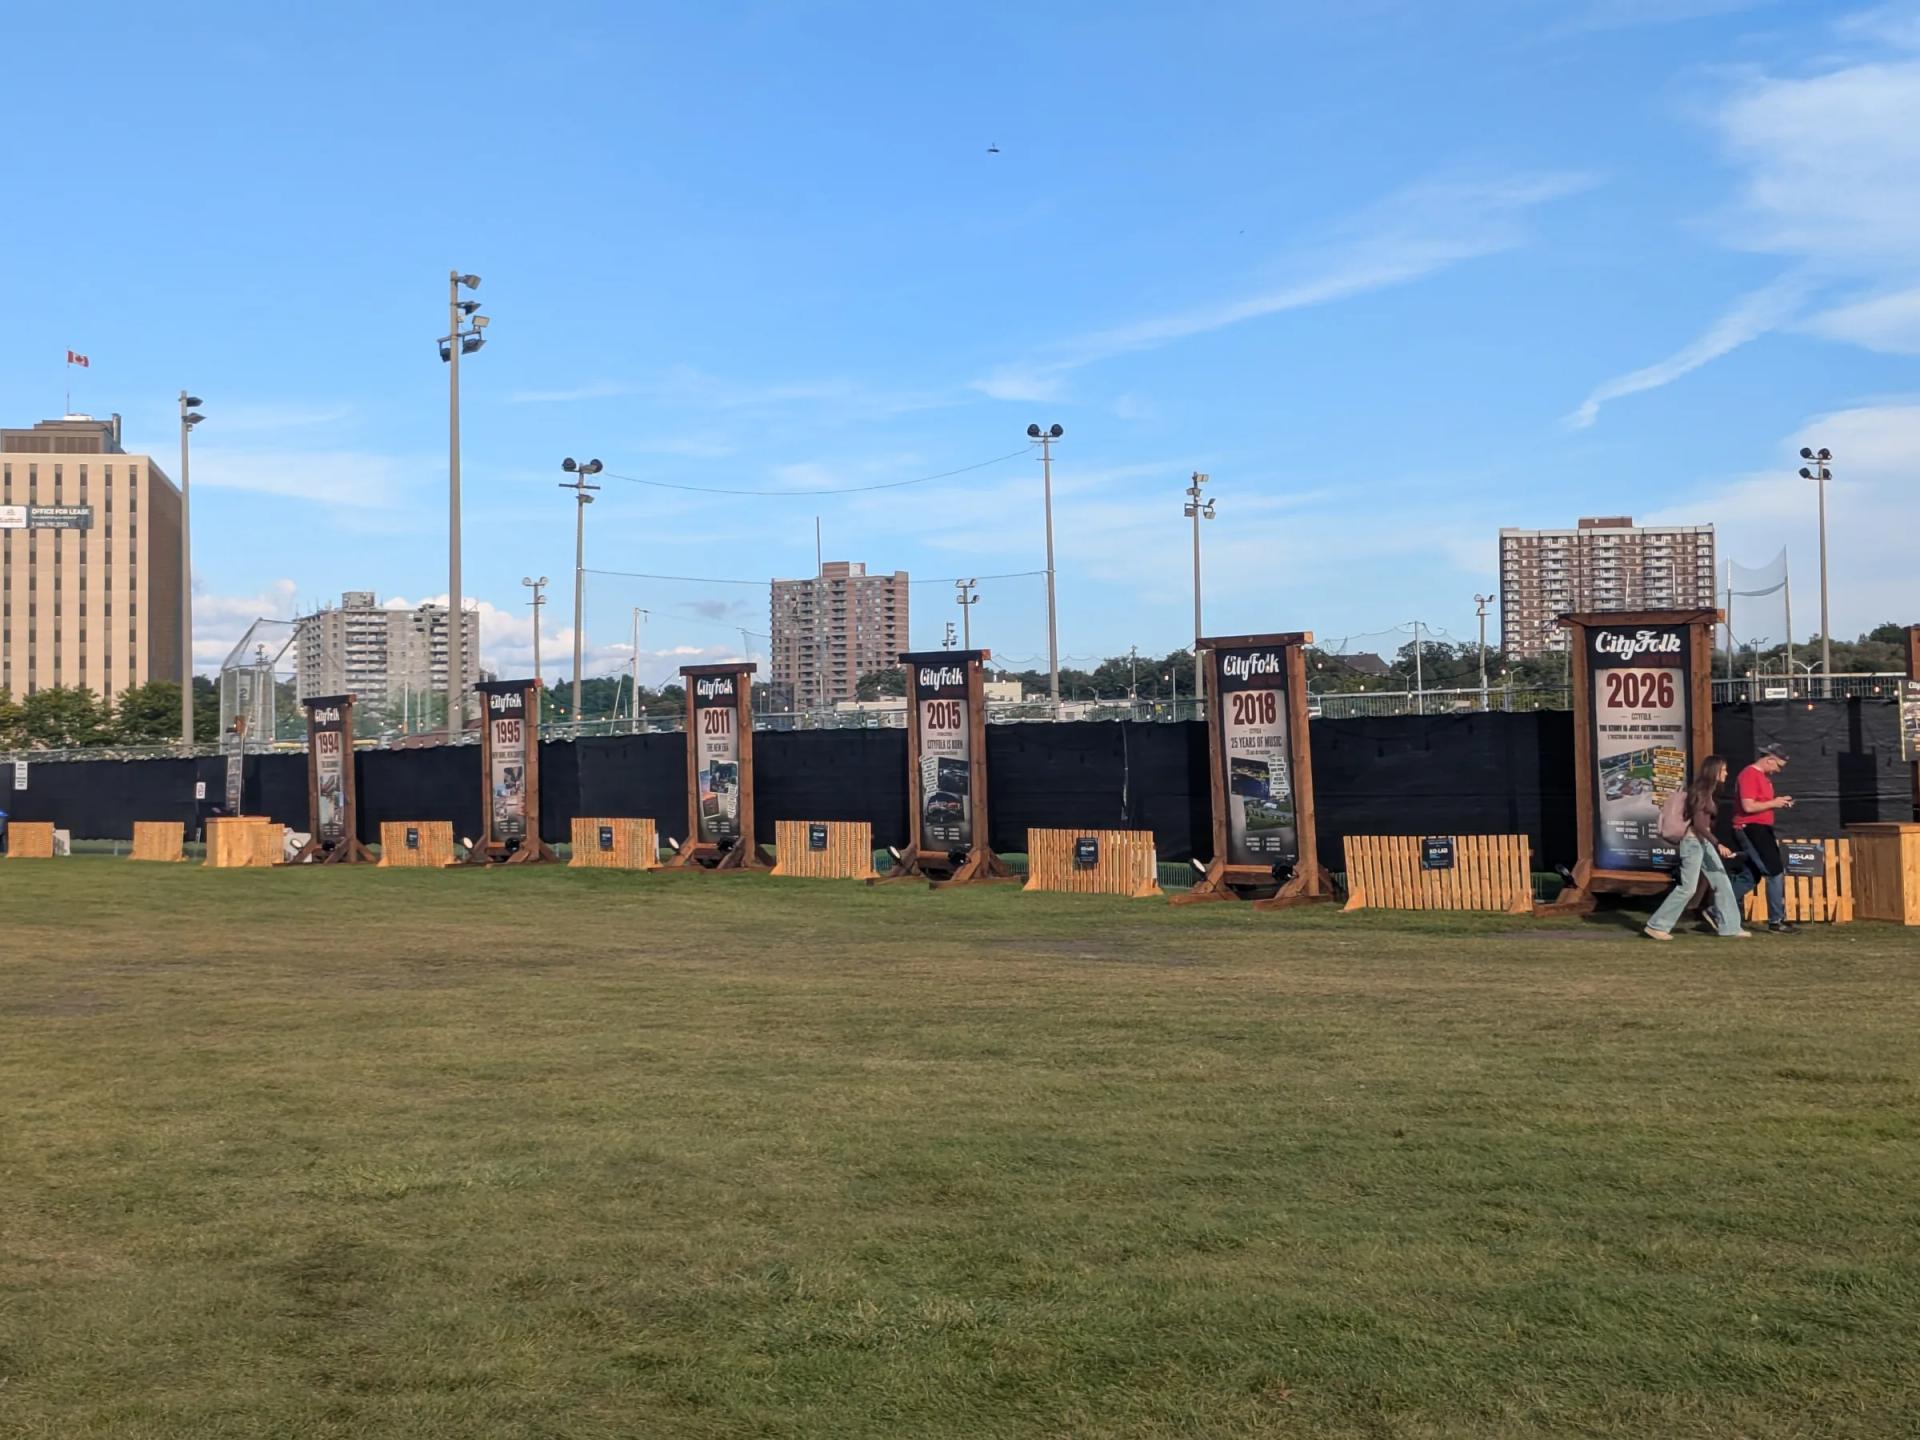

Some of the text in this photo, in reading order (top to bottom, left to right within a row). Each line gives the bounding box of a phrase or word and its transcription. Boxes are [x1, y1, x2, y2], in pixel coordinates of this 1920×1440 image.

[1595, 630, 1681, 660] CityFolk
[920, 666, 964, 691] CityFolk
[1223, 653, 1280, 681] CityFolk
[1606, 672, 1674, 708] 2026
[927, 701, 961, 729] 2015
[1232, 692, 1277, 725] 2018
[495, 720, 520, 744] 1995
[704, 709, 730, 734] 2011
[319, 733, 339, 753] 1994
[927, 739, 946, 749] CITYFOLK
[947, 739, 951, 749] IS
[1230, 735, 1282, 748] 25 YEARS OF MUSIC
